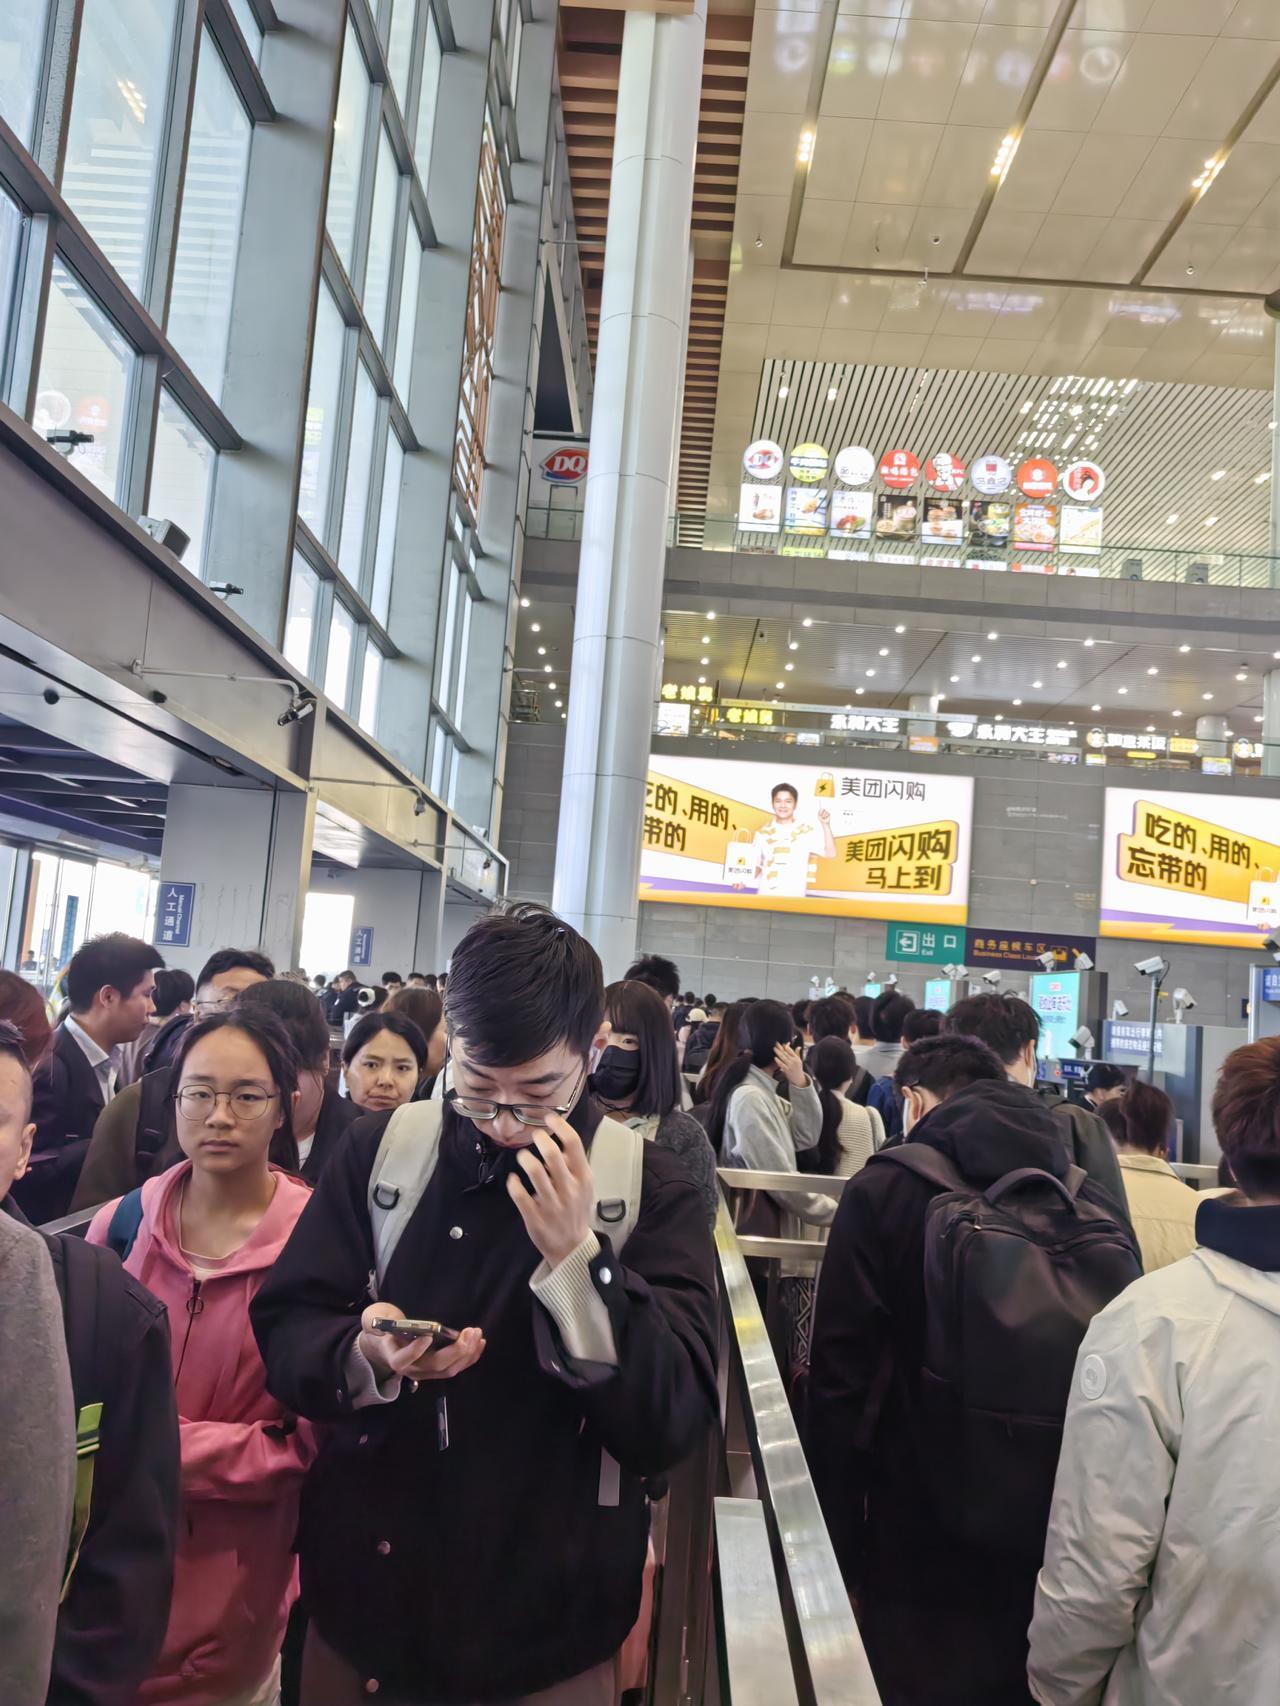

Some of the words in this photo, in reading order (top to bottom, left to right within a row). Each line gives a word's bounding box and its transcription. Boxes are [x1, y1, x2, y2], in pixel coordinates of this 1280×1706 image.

[552, 455, 587, 474] DQ
[661, 683, 714, 702] 老娘舅
[726, 707, 774, 725] 老娘舅
[830, 714, 900, 733] 永和大王
[976, 723, 1046, 744] 永和大王
[841, 776, 926, 801] 美团闪购
[845, 829, 952, 863] 美团闪购
[1145, 812, 1260, 870] 吃的、用的、
[866, 865, 943, 891] 马上到
[1128, 846, 1208, 891] 忘带的
[162, 887, 178, 941] 人工通道
[922, 932, 957, 948] 出口
[973, 938, 1047, 954] 商务座候车区
[921, 949, 934, 957] Exit
[973, 949, 1002, 958] Business
[1003, 951, 1022, 960] Class
